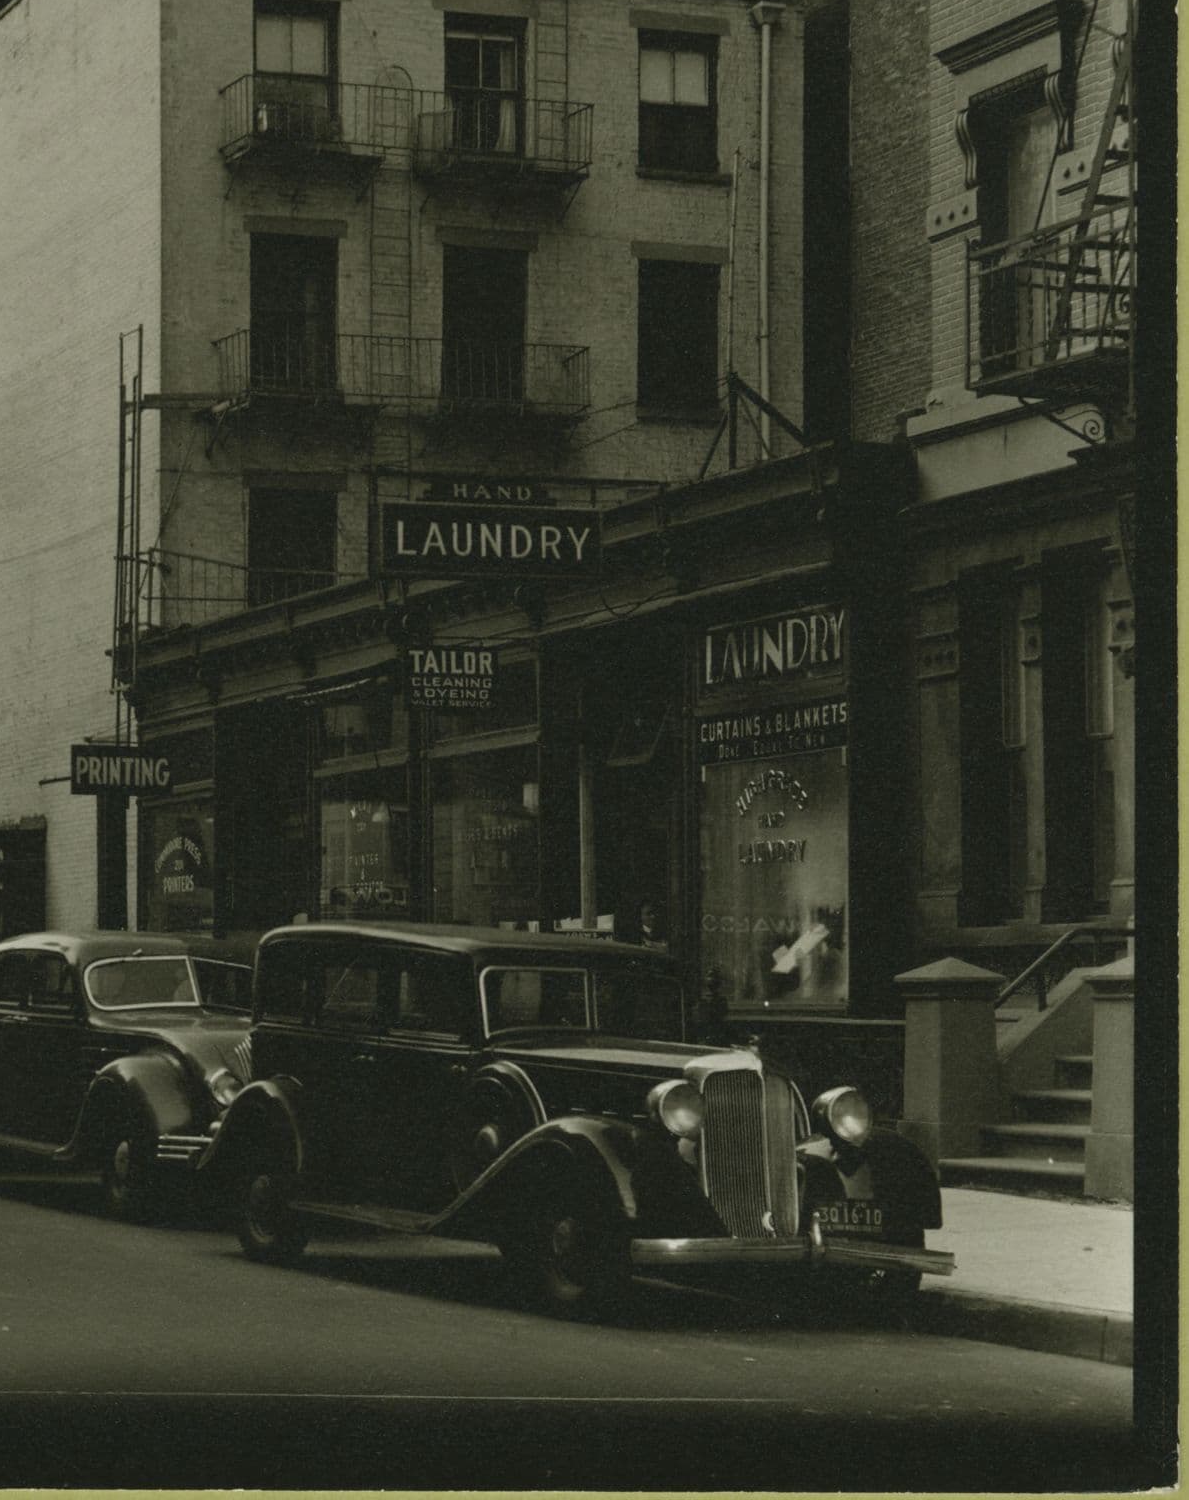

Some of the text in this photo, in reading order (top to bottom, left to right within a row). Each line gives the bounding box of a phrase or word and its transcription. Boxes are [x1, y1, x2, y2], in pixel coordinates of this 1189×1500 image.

[452, 482, 532, 501] HAND
[396, 519, 591, 561] LAUNDRY
[705, 608, 846, 685] LAUNDRY
[408, 649, 494, 675] TAILOR
[411, 676, 493, 689] CLEANING
[412, 687, 490, 699] & DYEING
[700, 715, 761, 743] CURTAINS
[775, 701, 848, 733] BLANKETS
[75, 755, 171, 787] PRINTING
